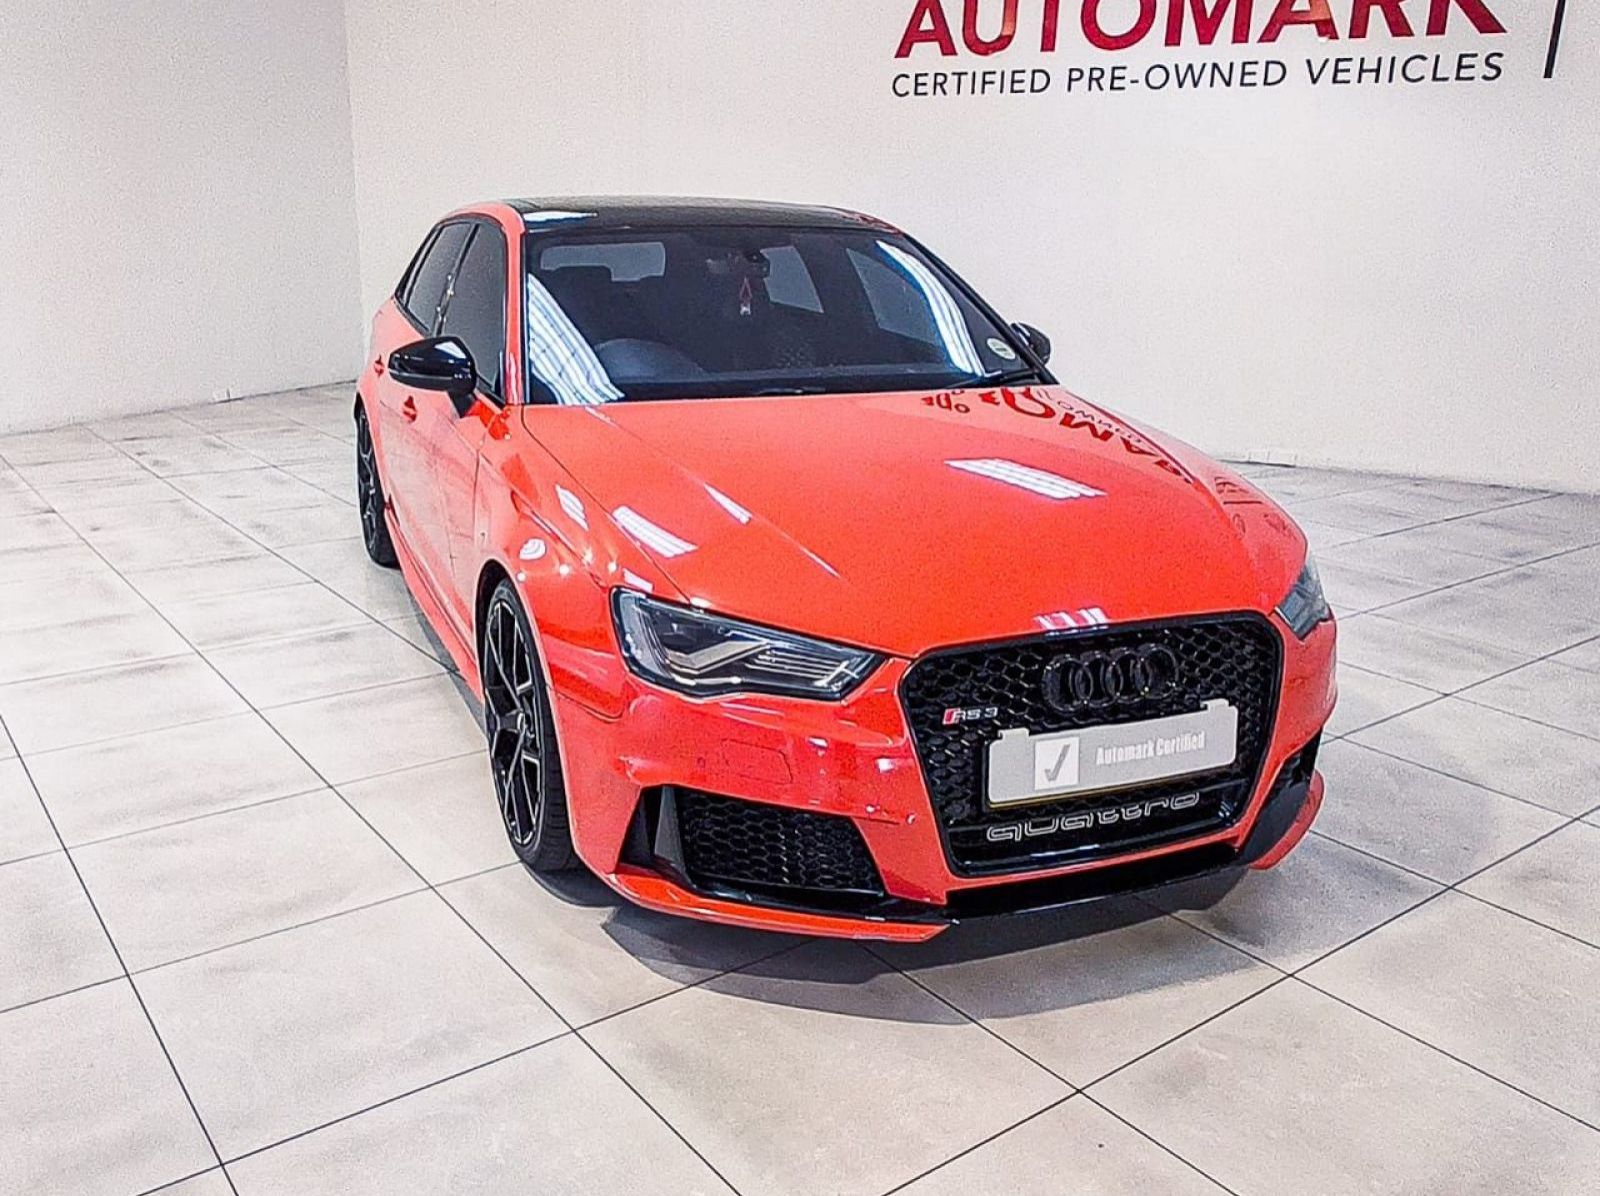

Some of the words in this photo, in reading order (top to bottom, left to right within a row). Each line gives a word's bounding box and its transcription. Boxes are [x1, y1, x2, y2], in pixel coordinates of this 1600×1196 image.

[891, 68, 1051, 97] CERTIFIED
[1066, 61, 1287, 93] PRE-OWNED
[1306, 52, 1504, 85] VEHICLES
[1095, 741, 1155, 765] Automark
[1155, 731, 1205, 756] Certified
[986, 792, 1199, 842] quattro
